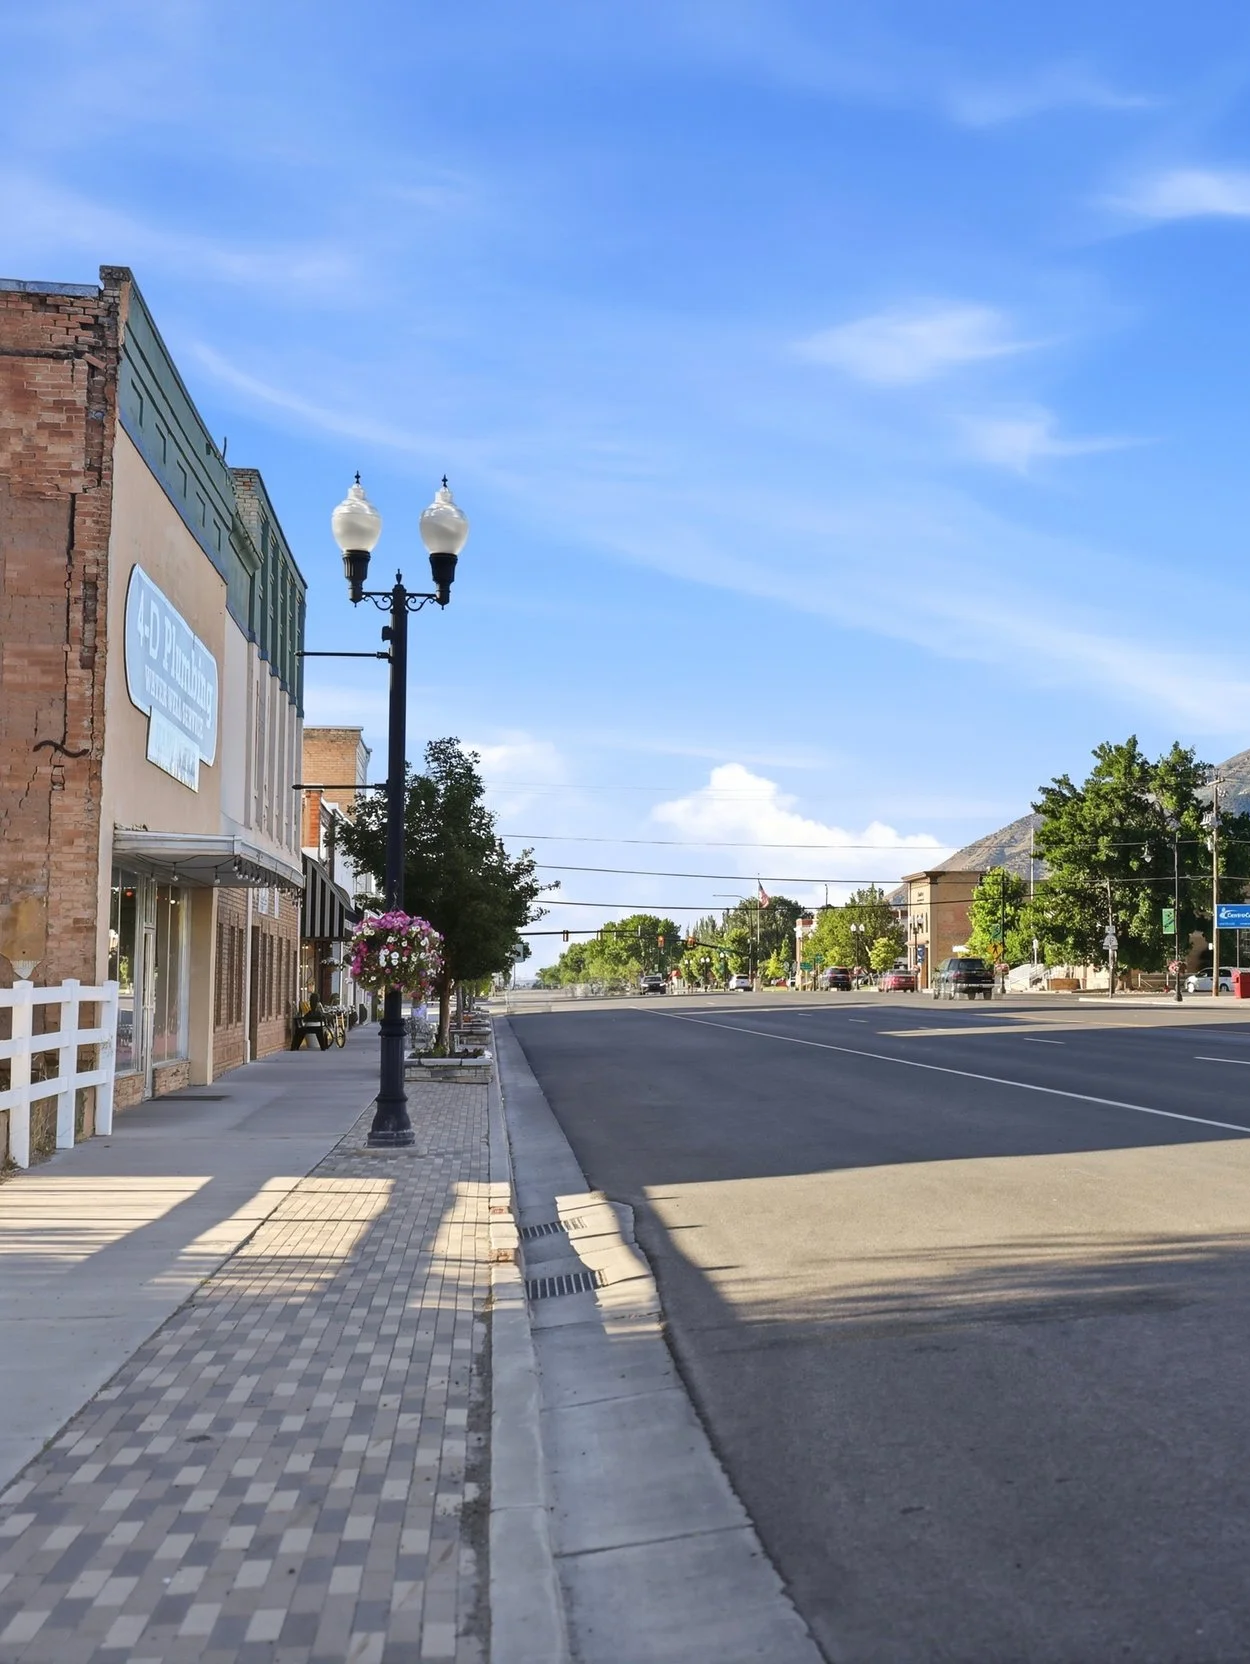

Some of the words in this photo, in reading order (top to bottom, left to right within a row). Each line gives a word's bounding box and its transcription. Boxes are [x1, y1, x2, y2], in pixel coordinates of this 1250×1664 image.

[137, 589, 160, 660] 4-D
[163, 615, 213, 729] Plumbing
[145, 664, 167, 708] WATER
[167, 685, 182, 722] WELL
[182, 701, 204, 740] SERVICE
